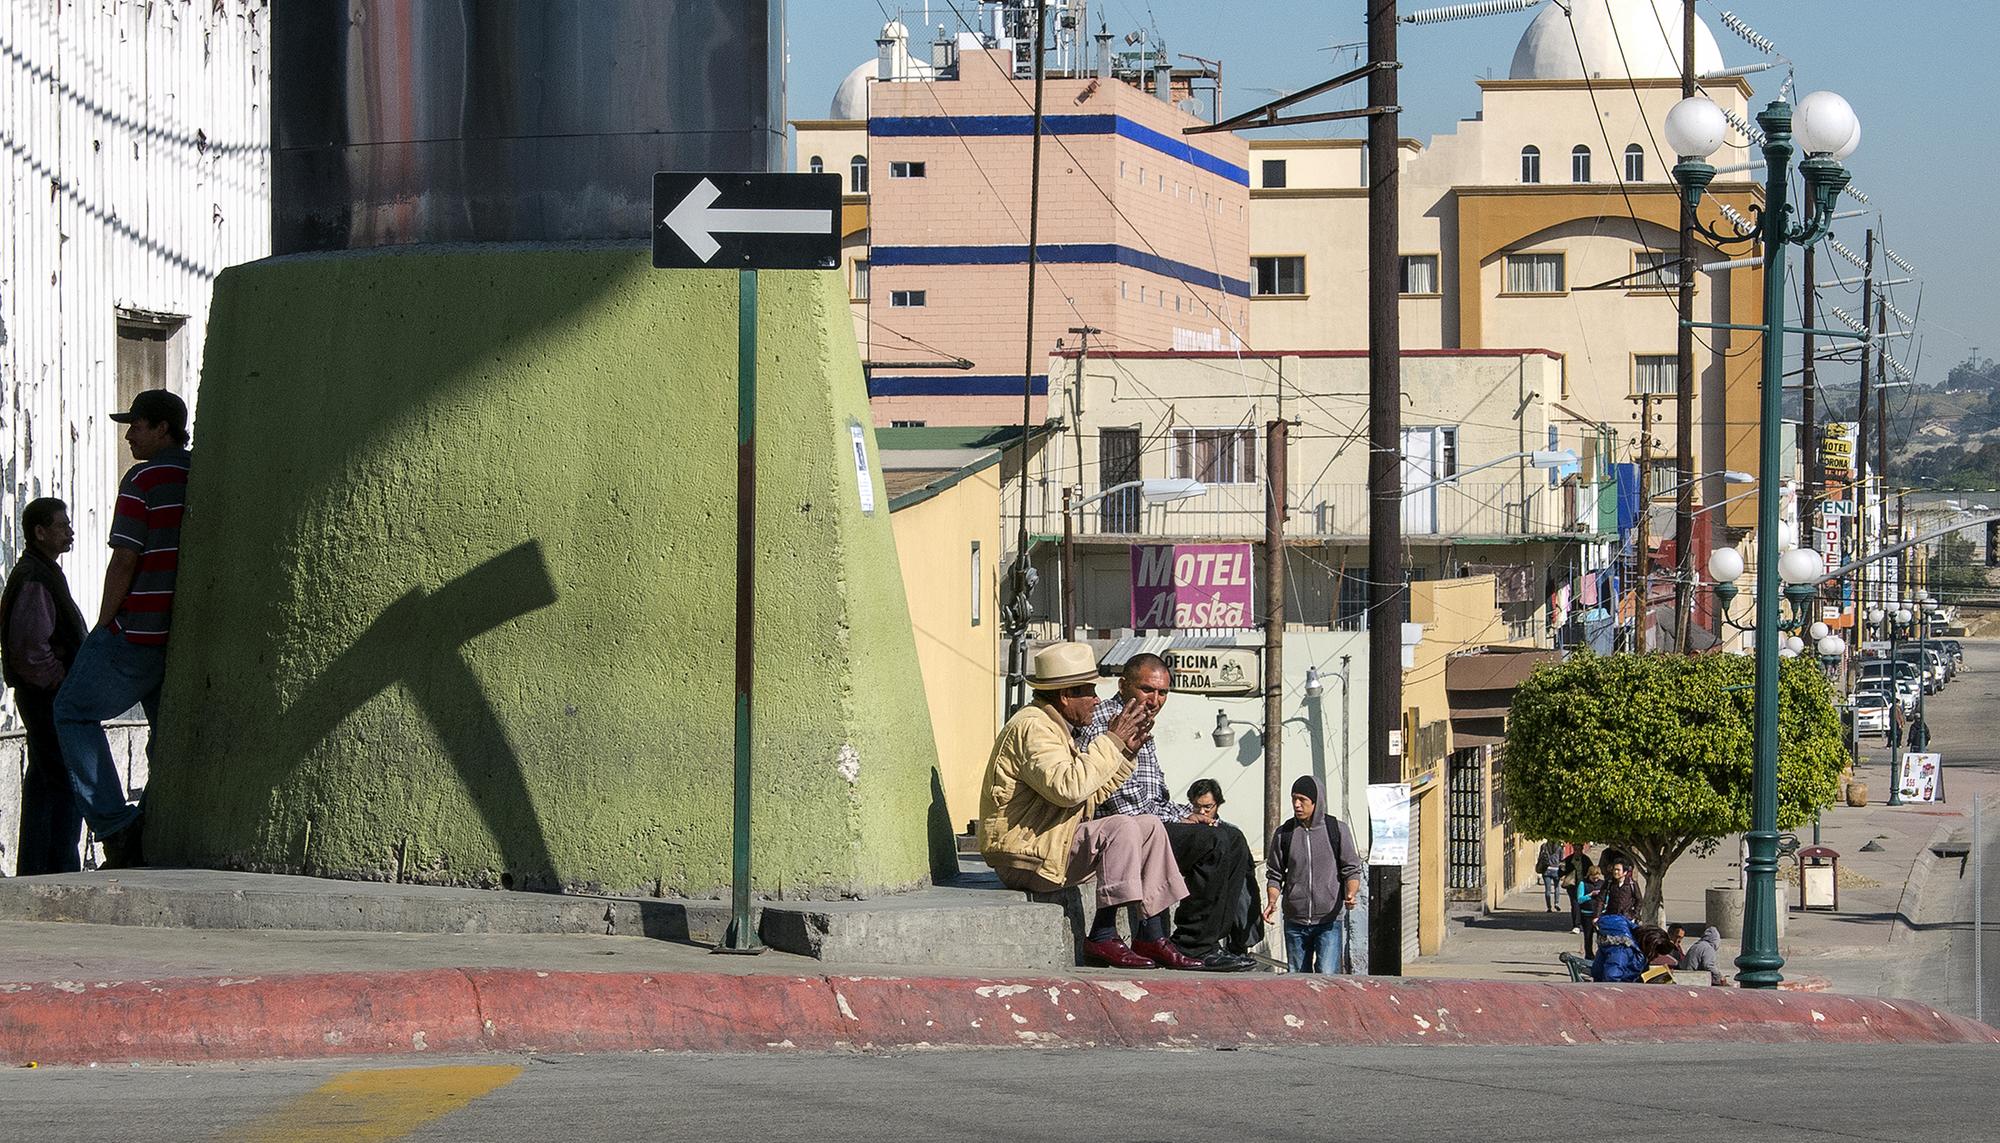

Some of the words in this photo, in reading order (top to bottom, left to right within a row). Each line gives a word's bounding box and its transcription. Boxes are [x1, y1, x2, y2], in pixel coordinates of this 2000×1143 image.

[1822, 458, 1848, 468] ORONA
[1137, 546, 1247, 587] MOTEL
[1137, 591, 1245, 629] Alaska
[1165, 655, 1218, 669] OFICINA
[1169, 674, 1211, 688] NTRADA
